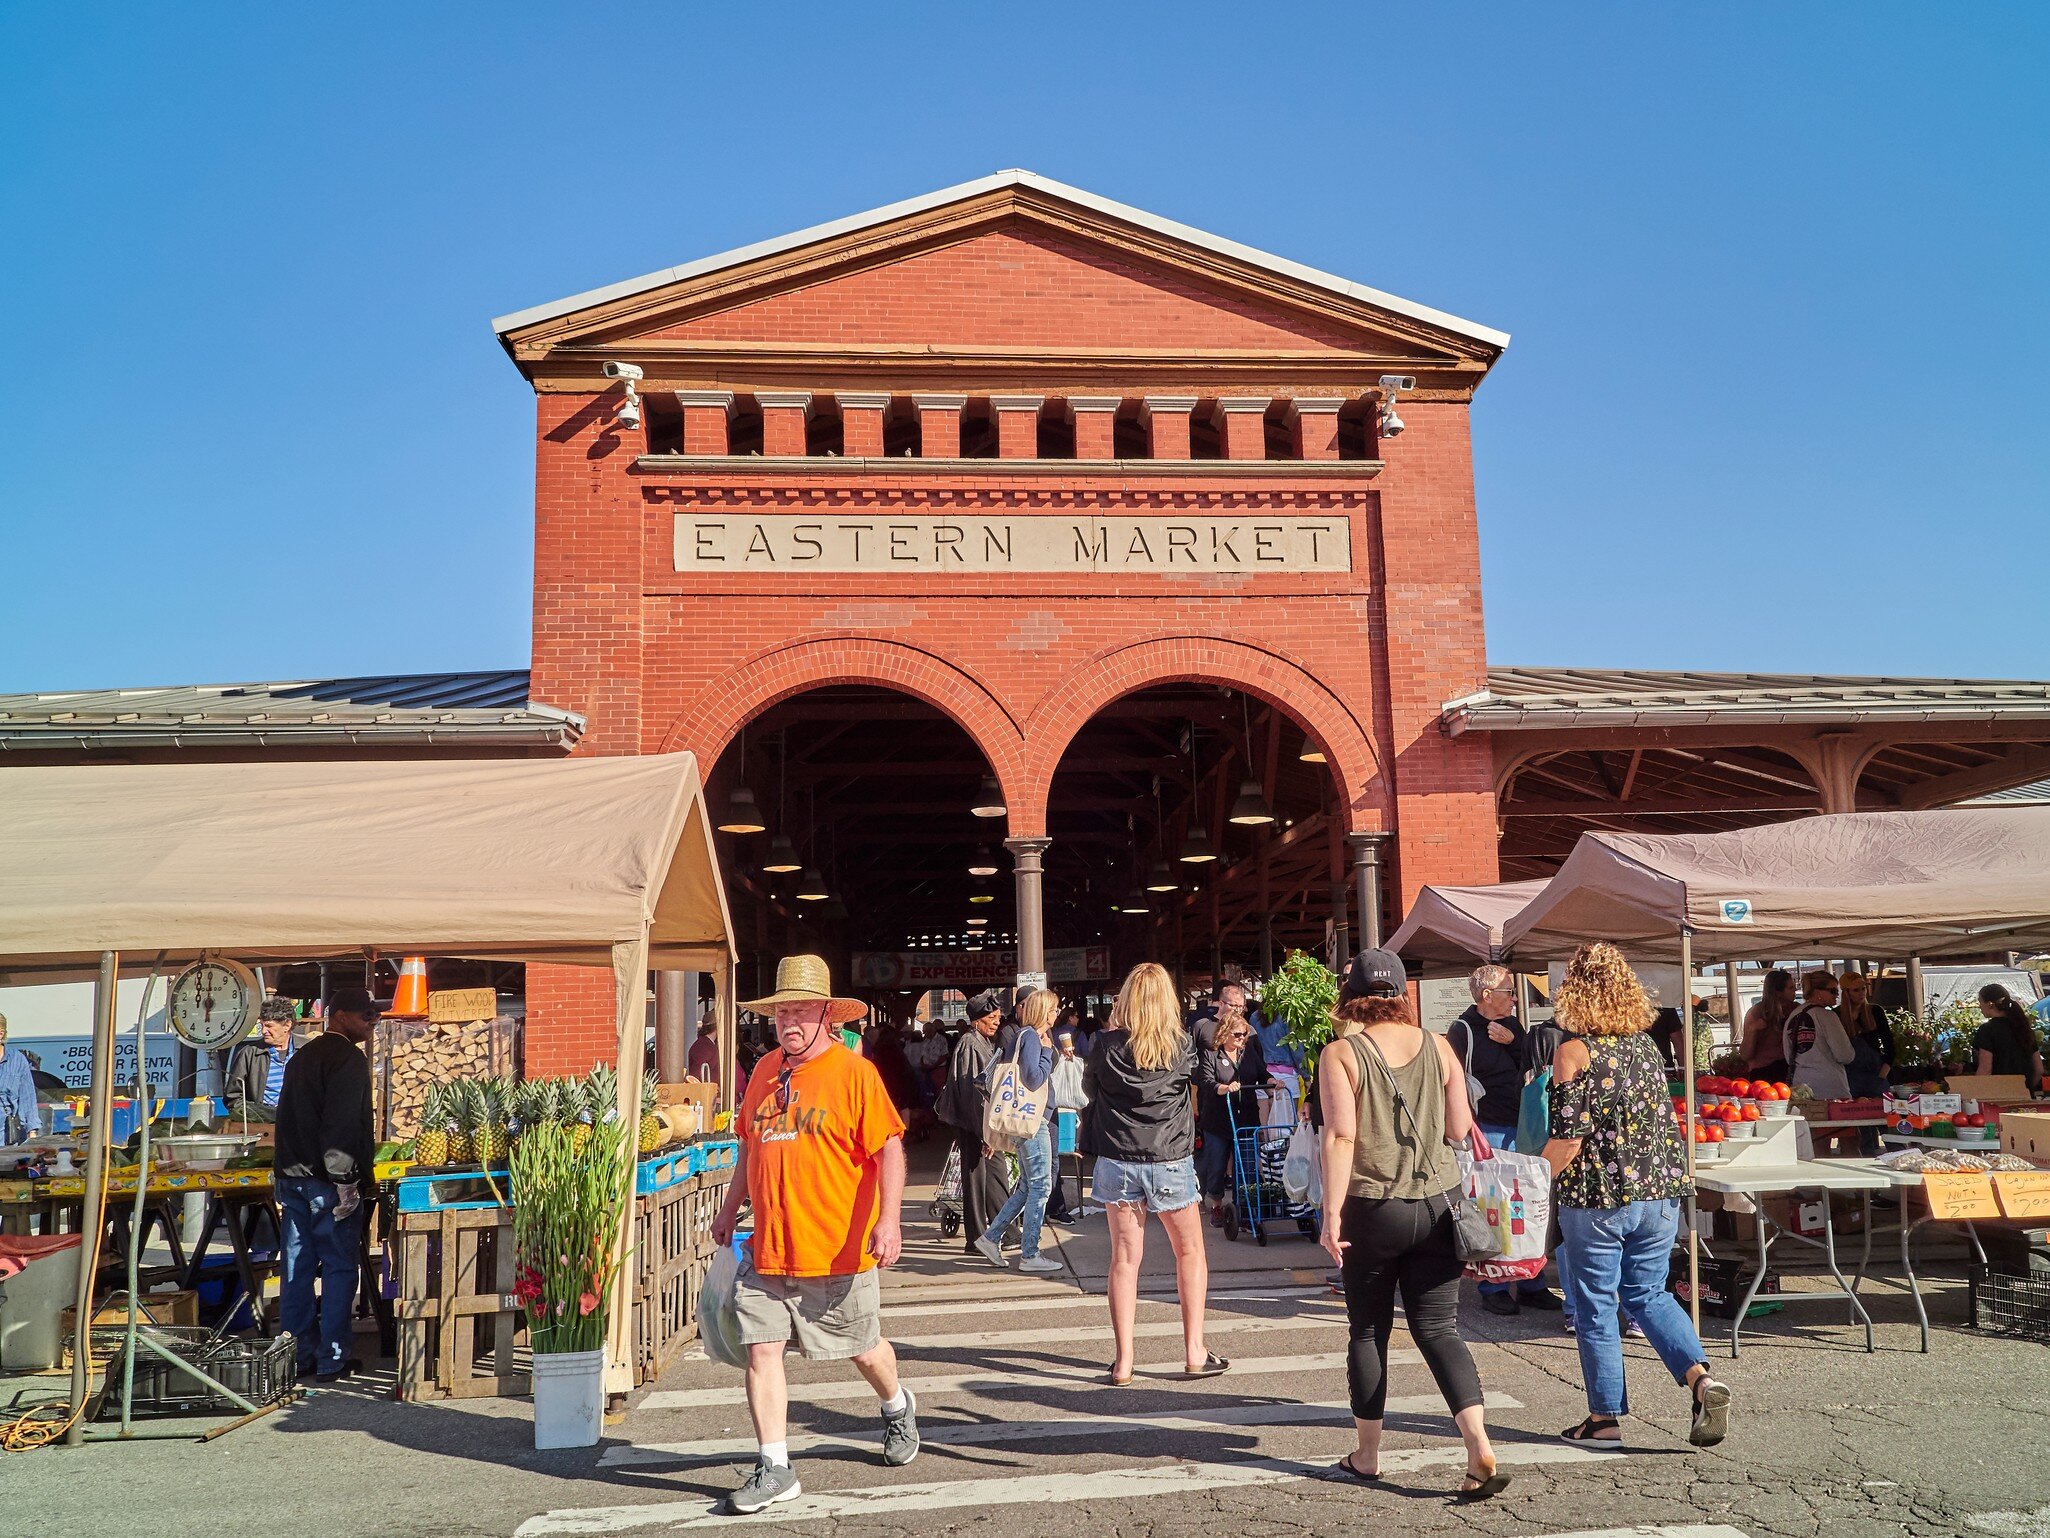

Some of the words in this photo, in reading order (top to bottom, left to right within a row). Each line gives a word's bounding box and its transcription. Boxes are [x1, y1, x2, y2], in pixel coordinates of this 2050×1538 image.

[695, 524, 1012, 562] EASTERN
[1073, 526, 1330, 563] MARKET
[948, 952, 997, 966] YOUR
[1088, 953, 1105, 972] 4
[910, 965, 1018, 979] EXPERIENCE
[222, 976, 228, 985] 9
[182, 992, 188, 1001] 2
[232, 990, 238, 999] 8
[434, 993, 458, 1008] FIRE
[463, 992, 495, 1007] WOOD
[181, 1010, 187, 1018] 3
[189, 1023, 196, 1031] 4
[220, 1021, 226, 1030] 6
[205, 1027, 211, 1036] 5
[750, 1106, 827, 1136] MIAMI
